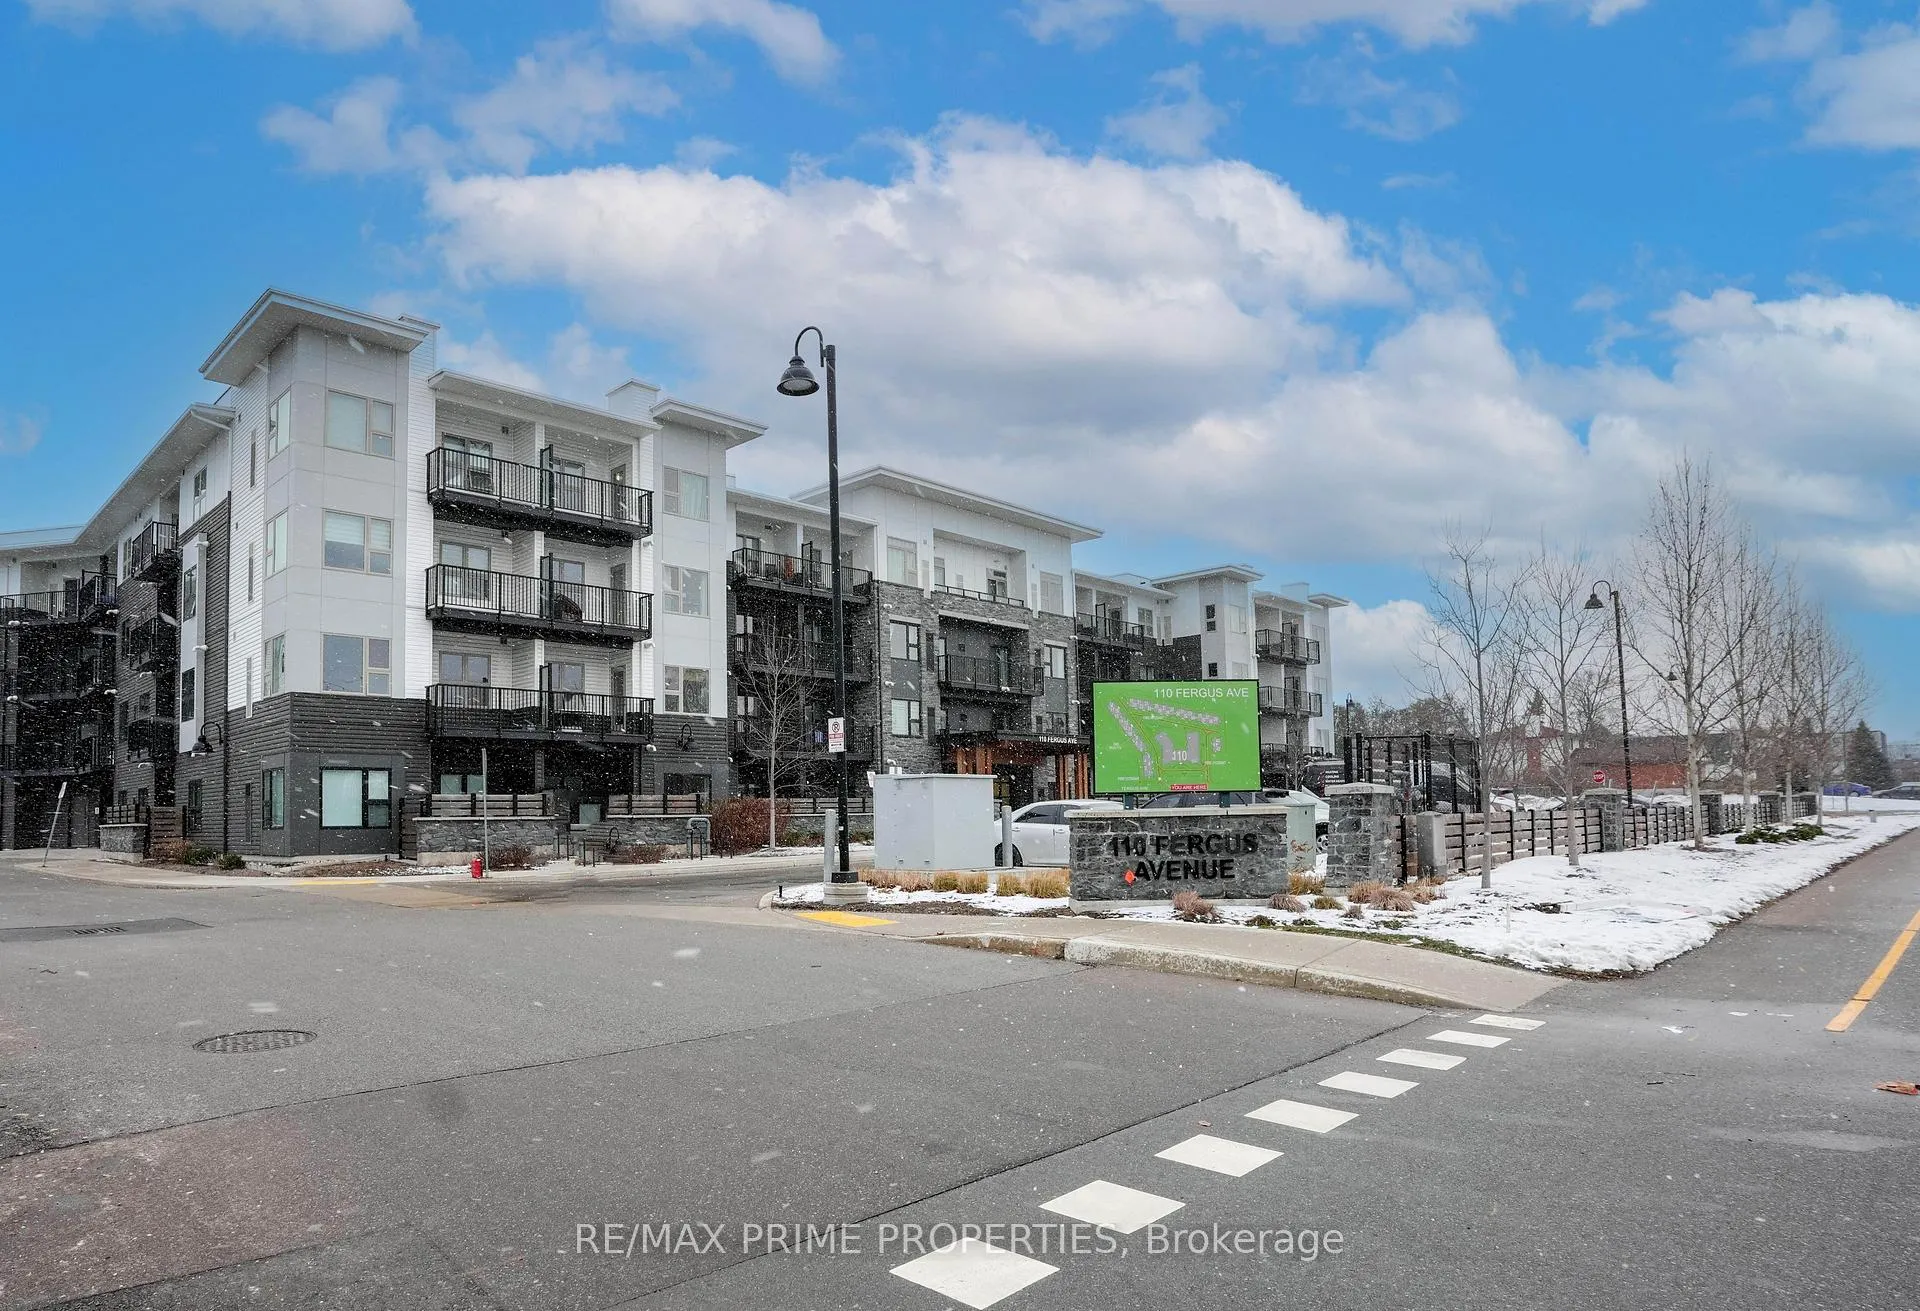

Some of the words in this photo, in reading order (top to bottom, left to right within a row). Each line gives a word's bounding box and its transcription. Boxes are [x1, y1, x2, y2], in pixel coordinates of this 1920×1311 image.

[1154, 688, 1173, 698] 110
[1176, 688, 1223, 698] FERGUS
[1226, 687, 1249, 697] AVE
[1172, 750, 1187, 761] 110
[1109, 836, 1147, 857] 110
[1154, 833, 1259, 855] FERGUS
[1134, 859, 1236, 881] AVENUE
